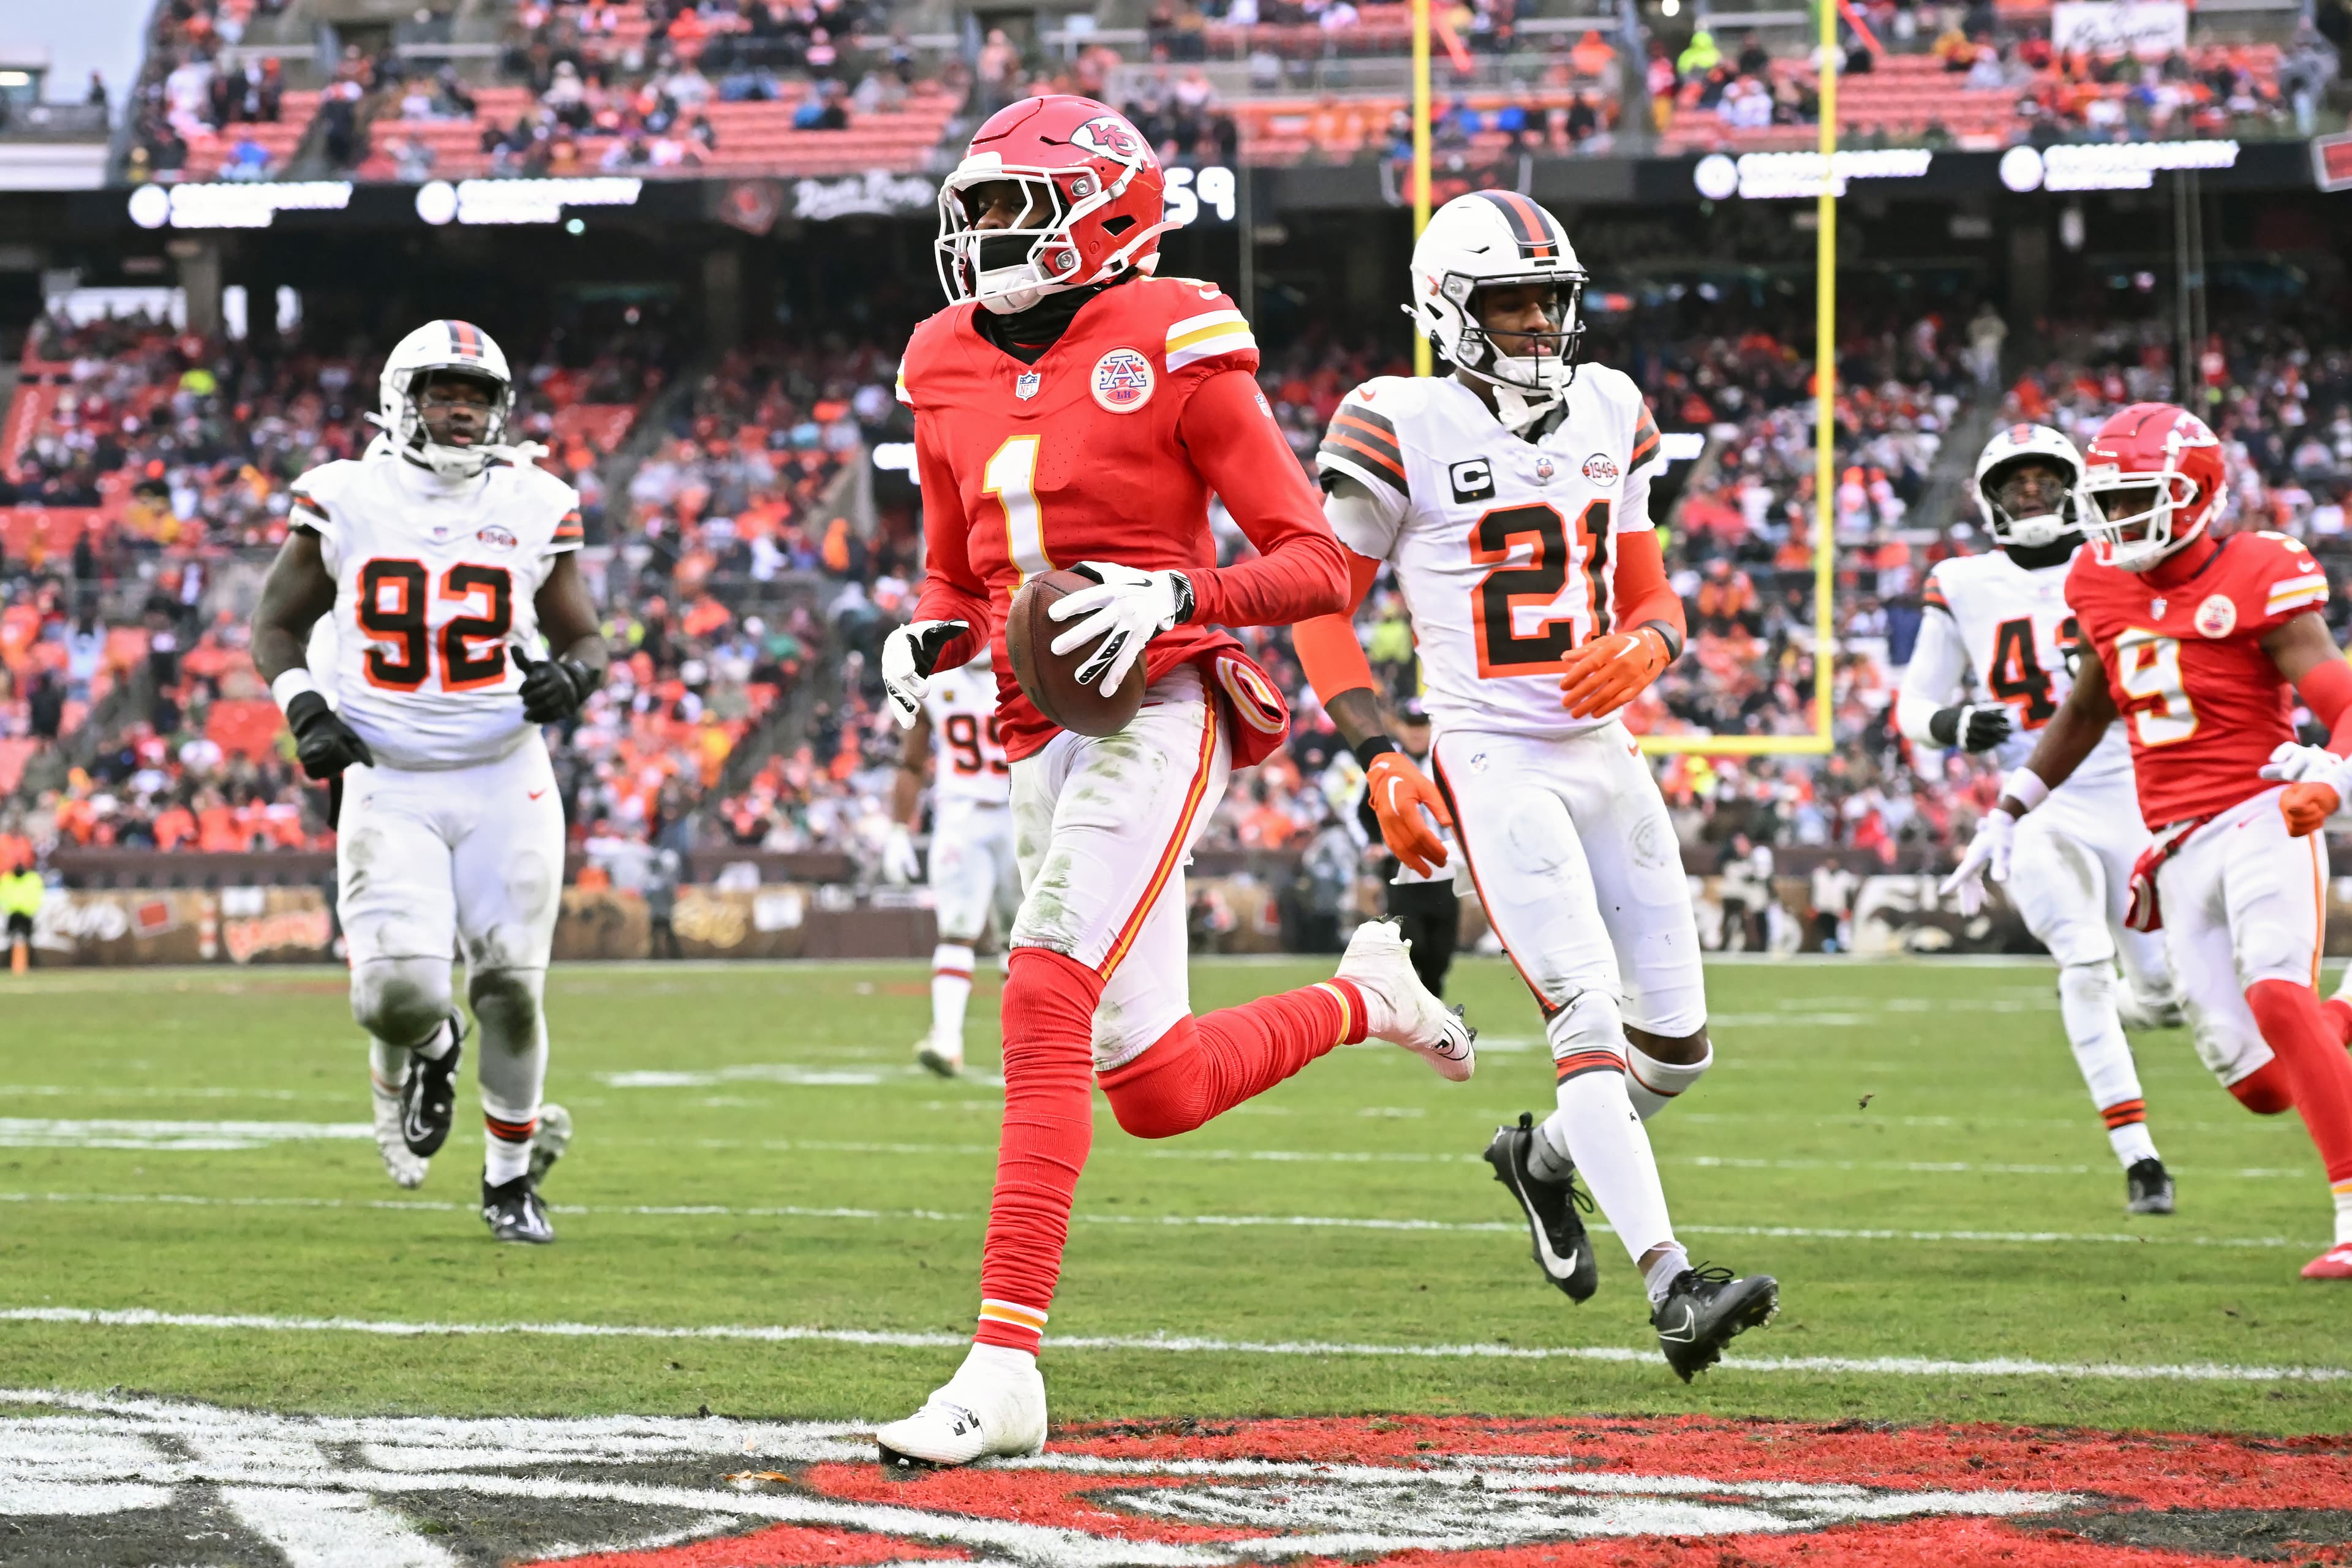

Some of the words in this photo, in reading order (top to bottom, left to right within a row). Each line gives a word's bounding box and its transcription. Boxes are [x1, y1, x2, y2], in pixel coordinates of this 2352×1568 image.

[1019, 384, 1035, 395] NFL
[1099, 355, 1147, 390] A
[1117, 391, 1132, 399] LH
[1452, 461, 1491, 492] C
[1589, 461, 1613, 479] 1946
[982, 434, 1057, 600] 1
[1468, 499, 1617, 679] 21
[356, 557, 513, 693] 92
[2114, 625, 2199, 748] 9
